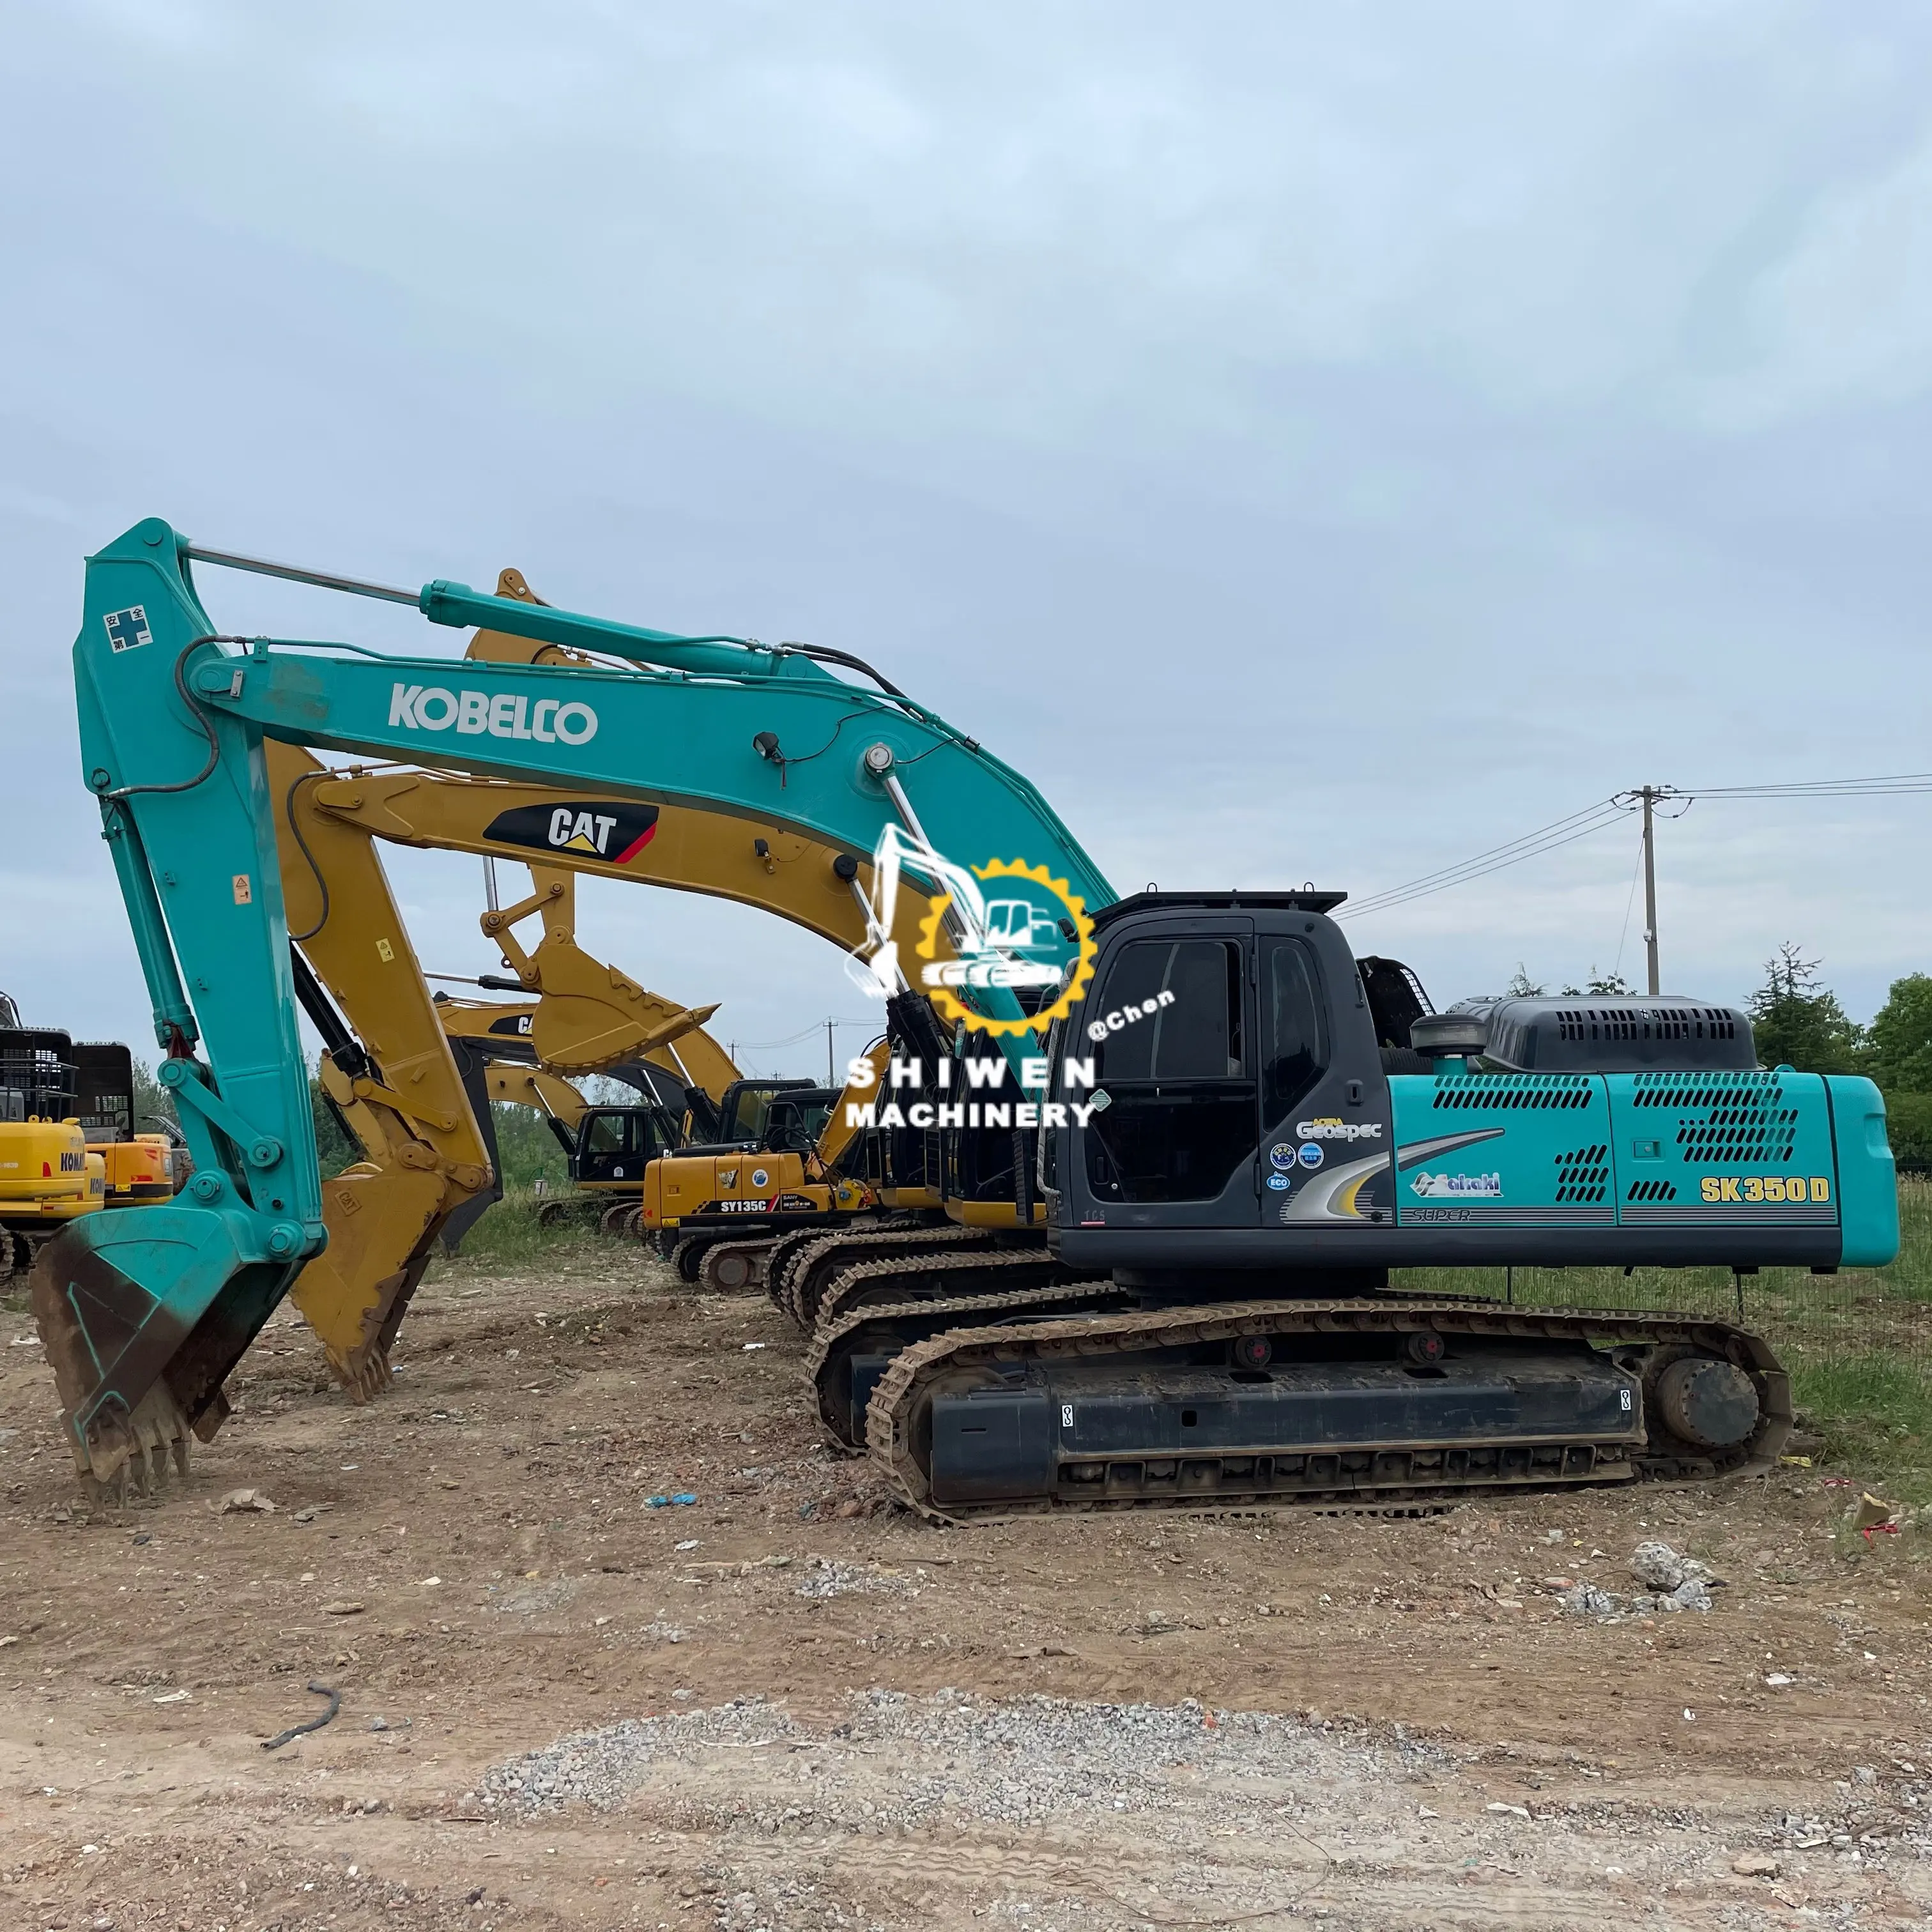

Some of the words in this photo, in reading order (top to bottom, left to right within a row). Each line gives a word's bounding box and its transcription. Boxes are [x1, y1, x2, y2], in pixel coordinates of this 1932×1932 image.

[388, 683, 598, 745] KOBELCO
[548, 808, 617, 854] CAT
[339, 1192, 358, 1210] CAT
[721, 1201, 766, 1212] SY135C
[1413, 1209, 1471, 1222] SUPER
